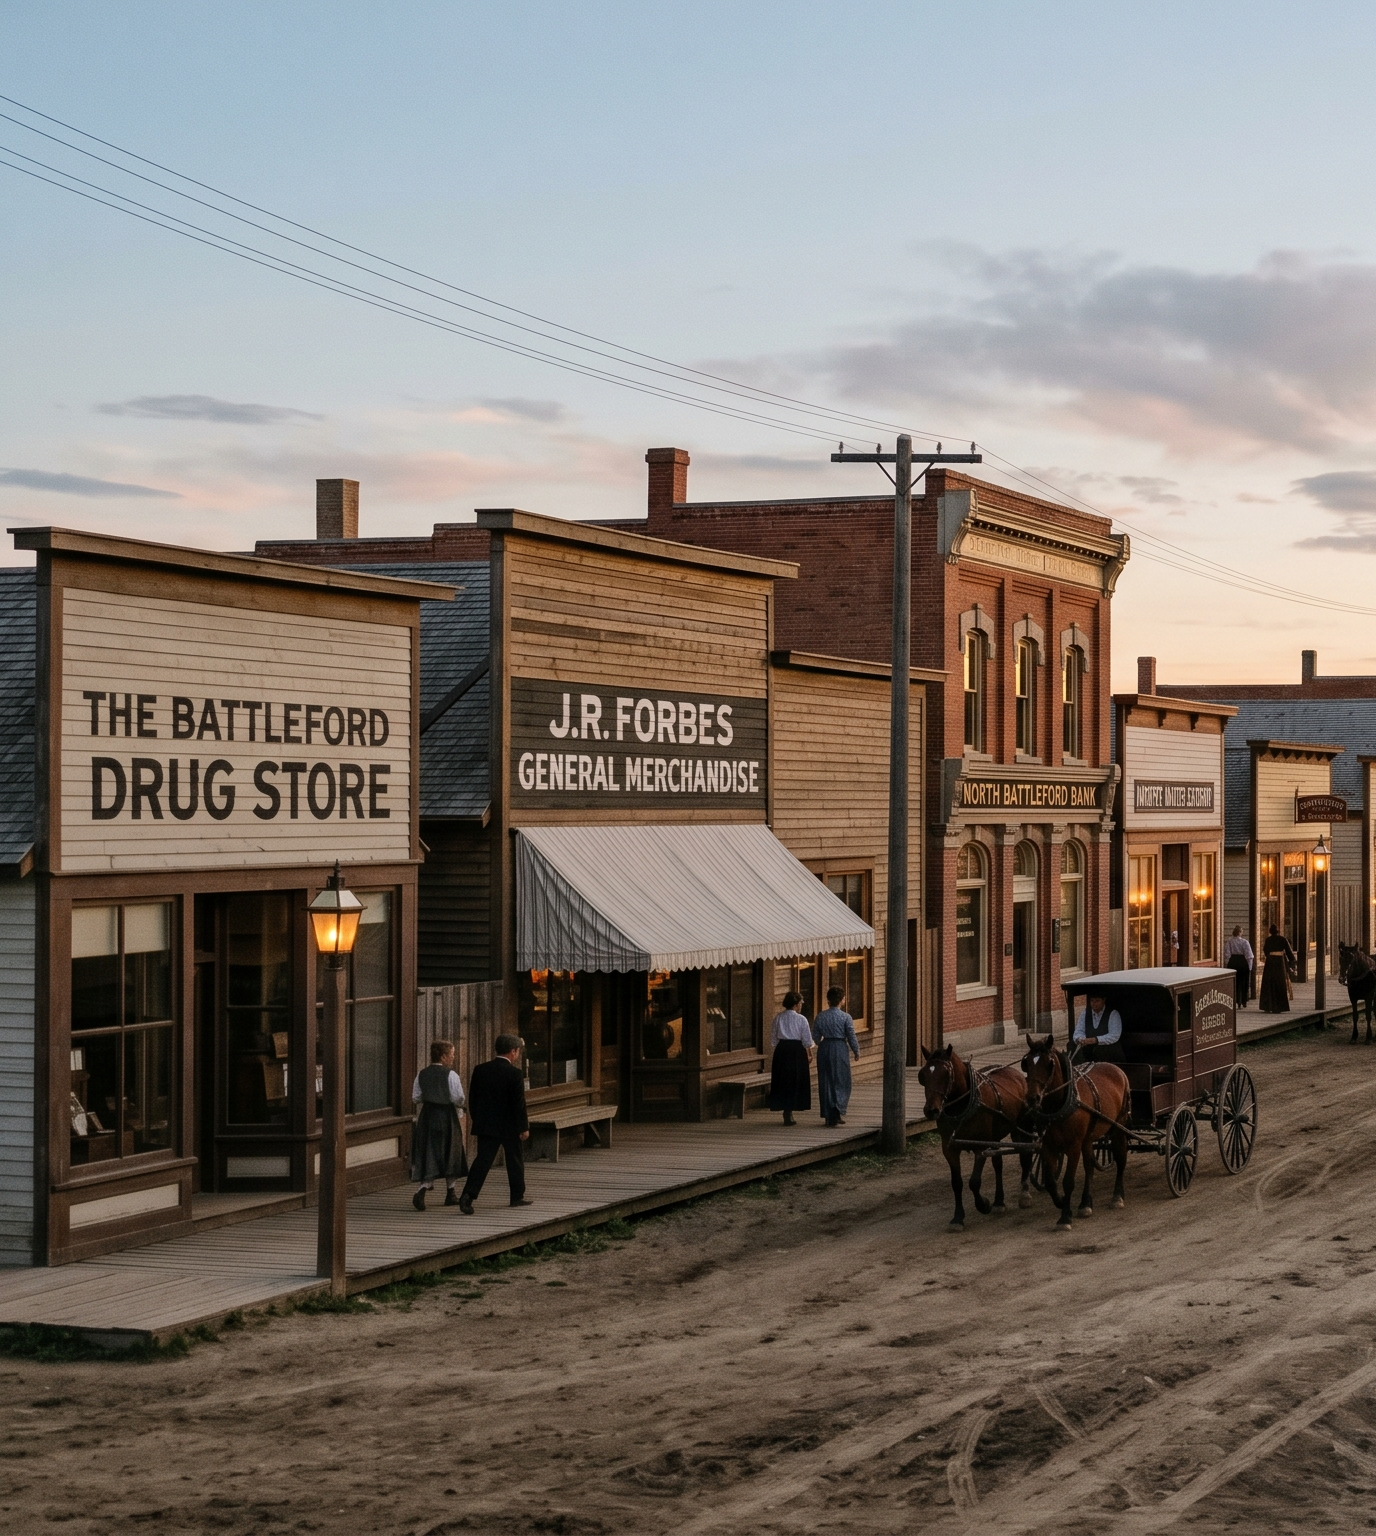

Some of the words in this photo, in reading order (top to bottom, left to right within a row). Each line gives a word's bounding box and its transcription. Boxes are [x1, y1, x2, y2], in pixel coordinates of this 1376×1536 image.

[83, 690, 157, 738] THE
[172, 696, 390, 746] BATTLEFORD
[549, 693, 610, 739] J.R.
[616, 697, 734, 746] FORBES
[91, 756, 236, 820] DRUG
[252, 760, 391, 820] STORE
[518, 752, 620, 791] GENERAL
[625, 756, 760, 793] MERCHANDISE
[963, 783, 1000, 805] NORTH
[1003, 784, 1068, 806] BATTLEFORD
[1070, 786, 1096, 806] BANK
